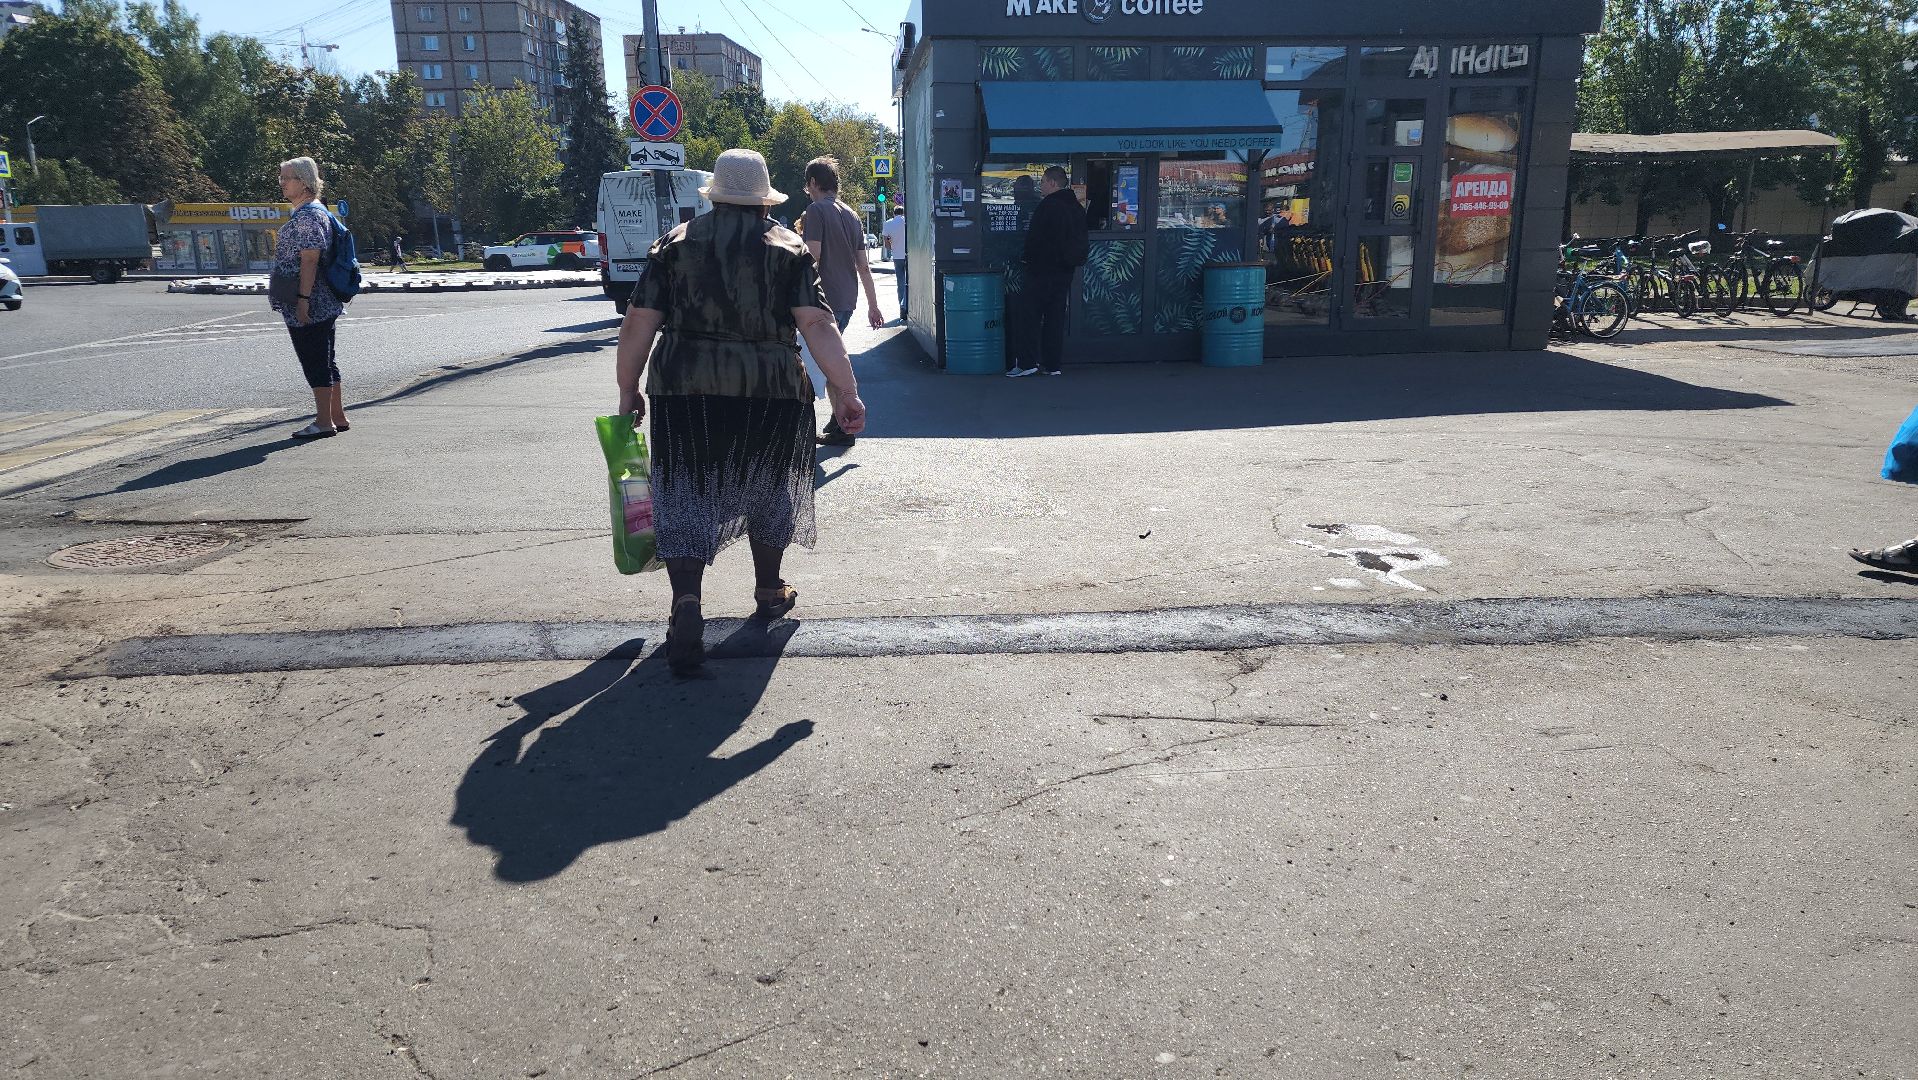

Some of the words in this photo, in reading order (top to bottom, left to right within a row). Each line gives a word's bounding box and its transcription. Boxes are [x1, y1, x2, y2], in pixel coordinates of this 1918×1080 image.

[1118, 139, 1137, 150] YOU
[1140, 139, 1164, 149] LOOK
[1167, 139, 1187, 149] LIKE
[1190, 138, 1208, 148] YOU
[1211, 138, 1236, 148] NEED
[1239, 137, 1275, 147] COFFEE
[1455, 181, 1508, 198] АРЕНДА
[229, 206, 281, 221] ЦВЕТЫ
